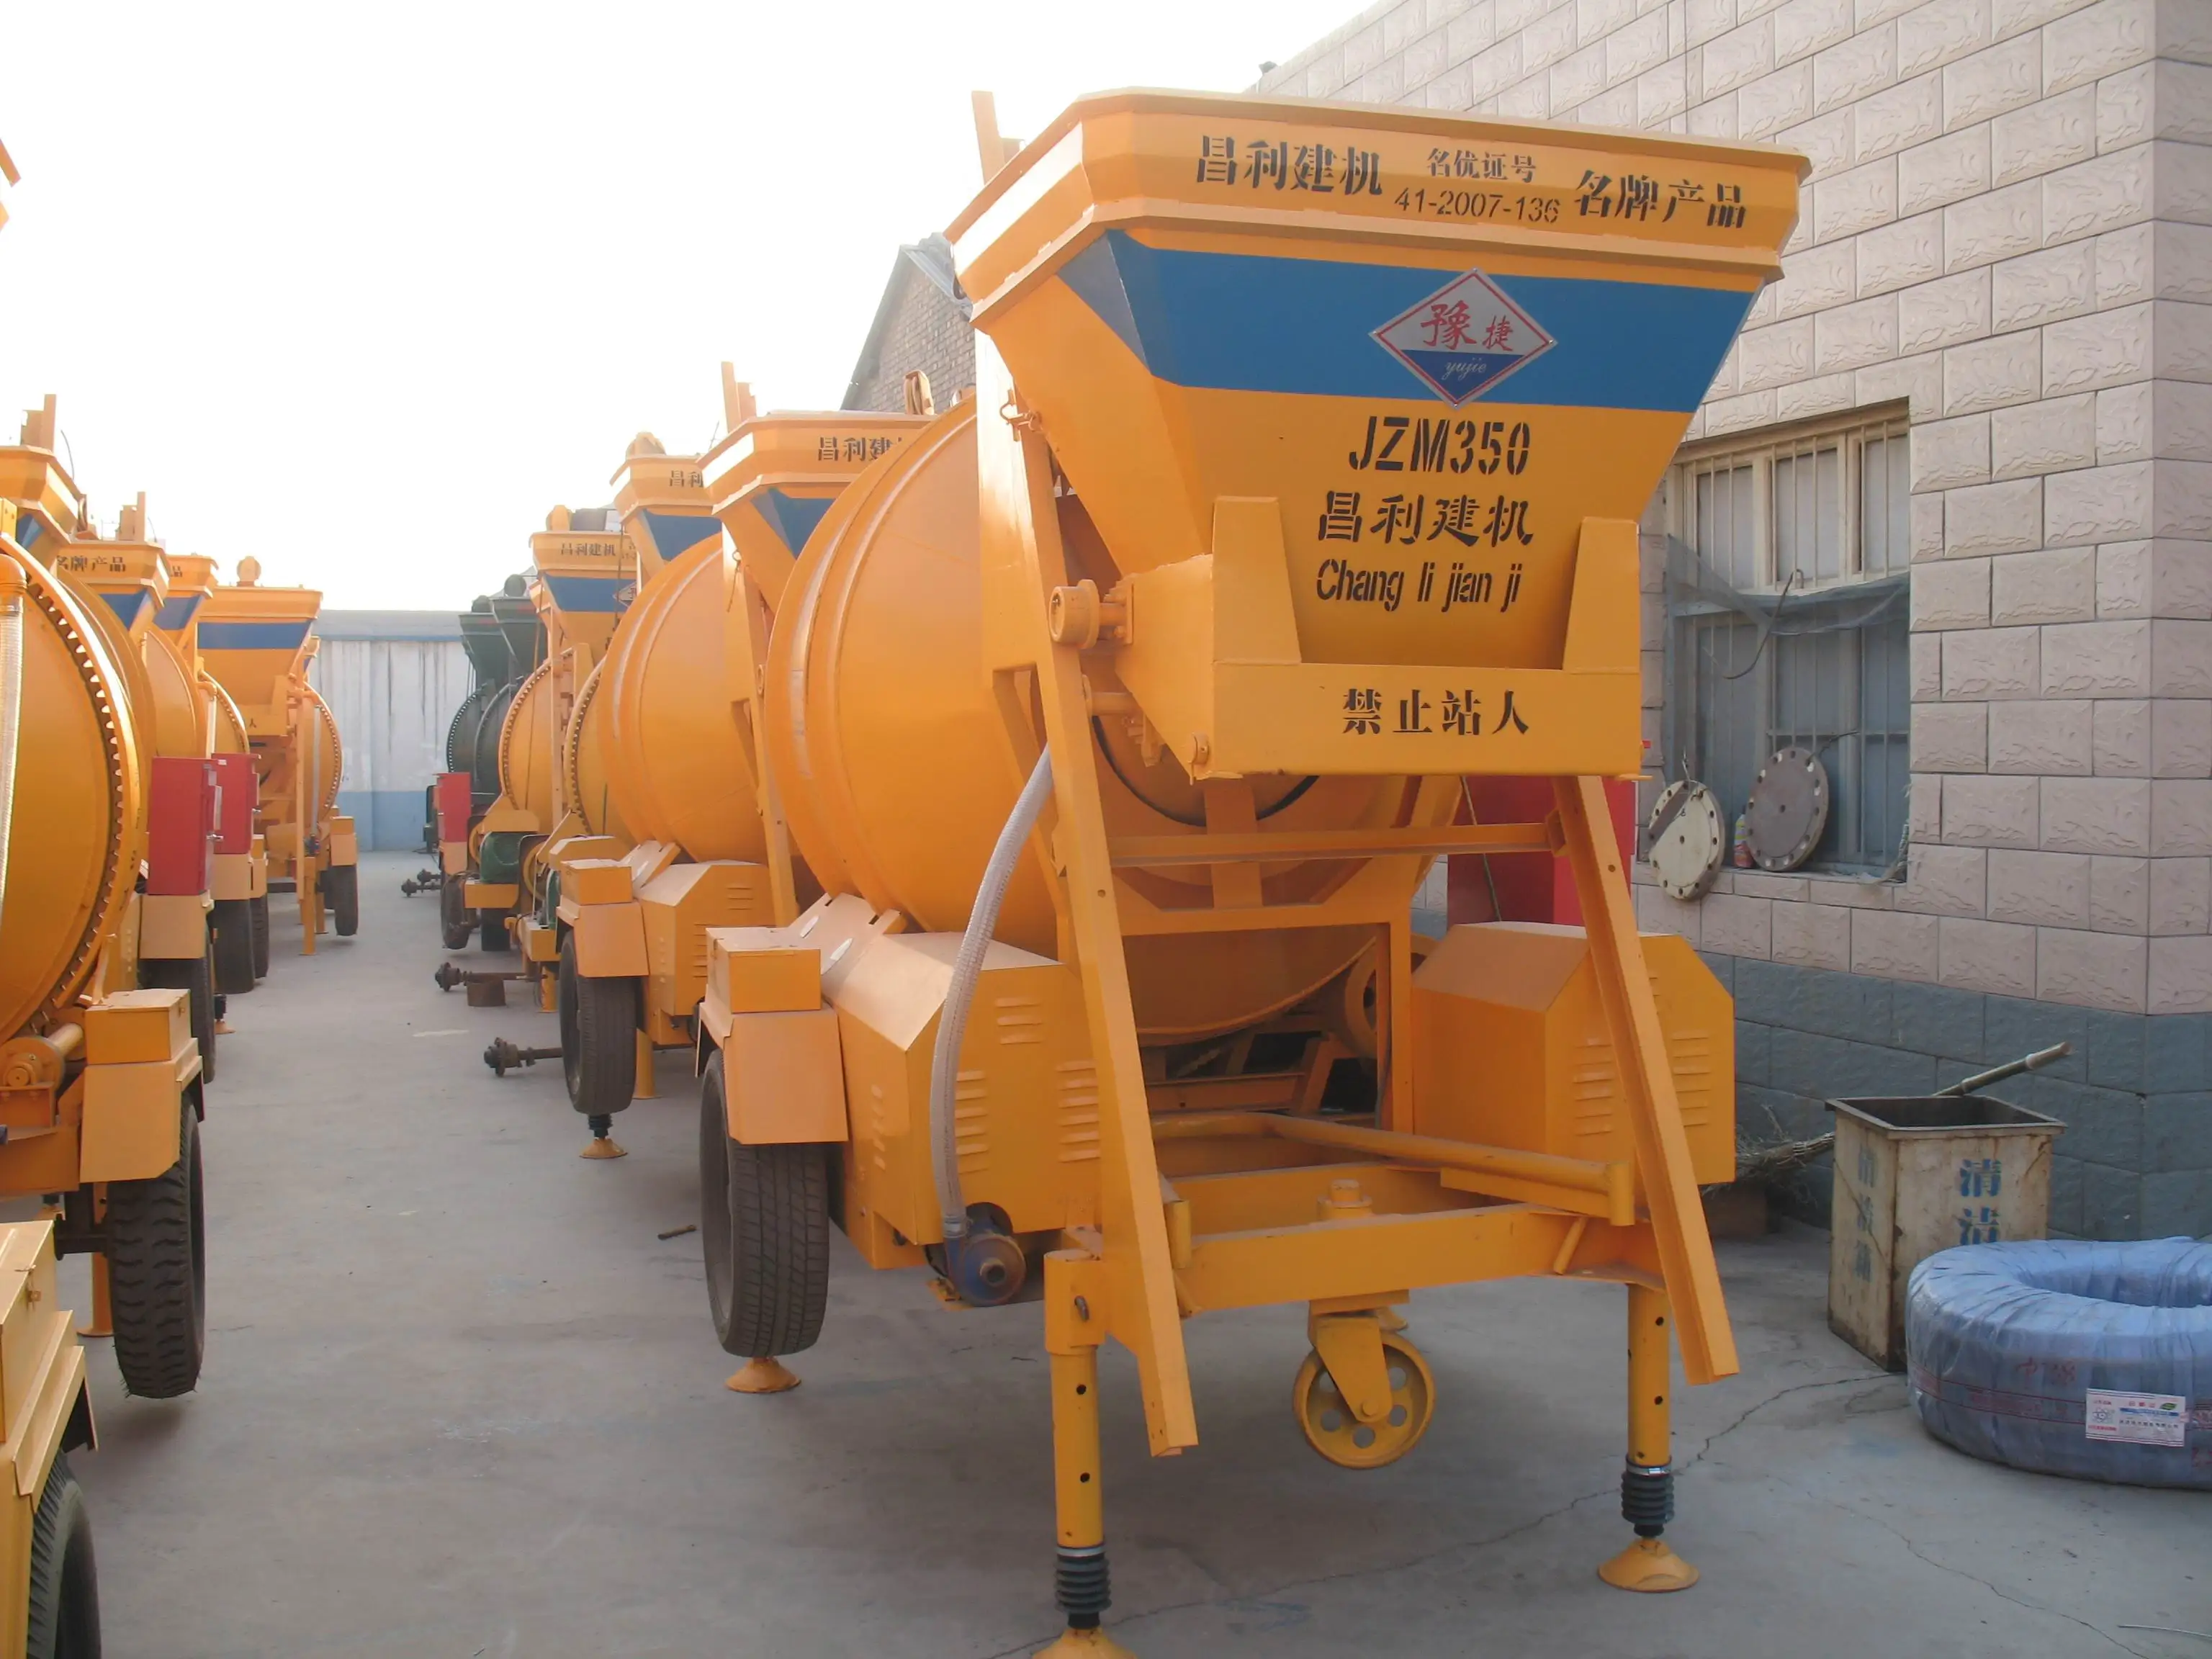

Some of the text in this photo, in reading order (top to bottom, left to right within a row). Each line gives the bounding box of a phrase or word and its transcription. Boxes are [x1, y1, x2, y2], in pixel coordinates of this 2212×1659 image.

[1197, 135, 1382, 196] 昌利建机
[1426, 148, 1537, 184] 名优证号
[1394, 186, 1561, 224] 41-2007-136
[1574, 169, 1747, 229] 名牌产品
[1421, 300, 1514, 351] 豫捷
[1442, 358, 1487, 381] yujie
[818, 436, 902, 462] 昌利建
[1349, 415, 1531, 476] JZM350
[1318, 490, 1534, 548] 昌利建机
[1316, 558, 1523, 613] Chang li jian ji
[1343, 688, 1529, 736] 禁止站人
